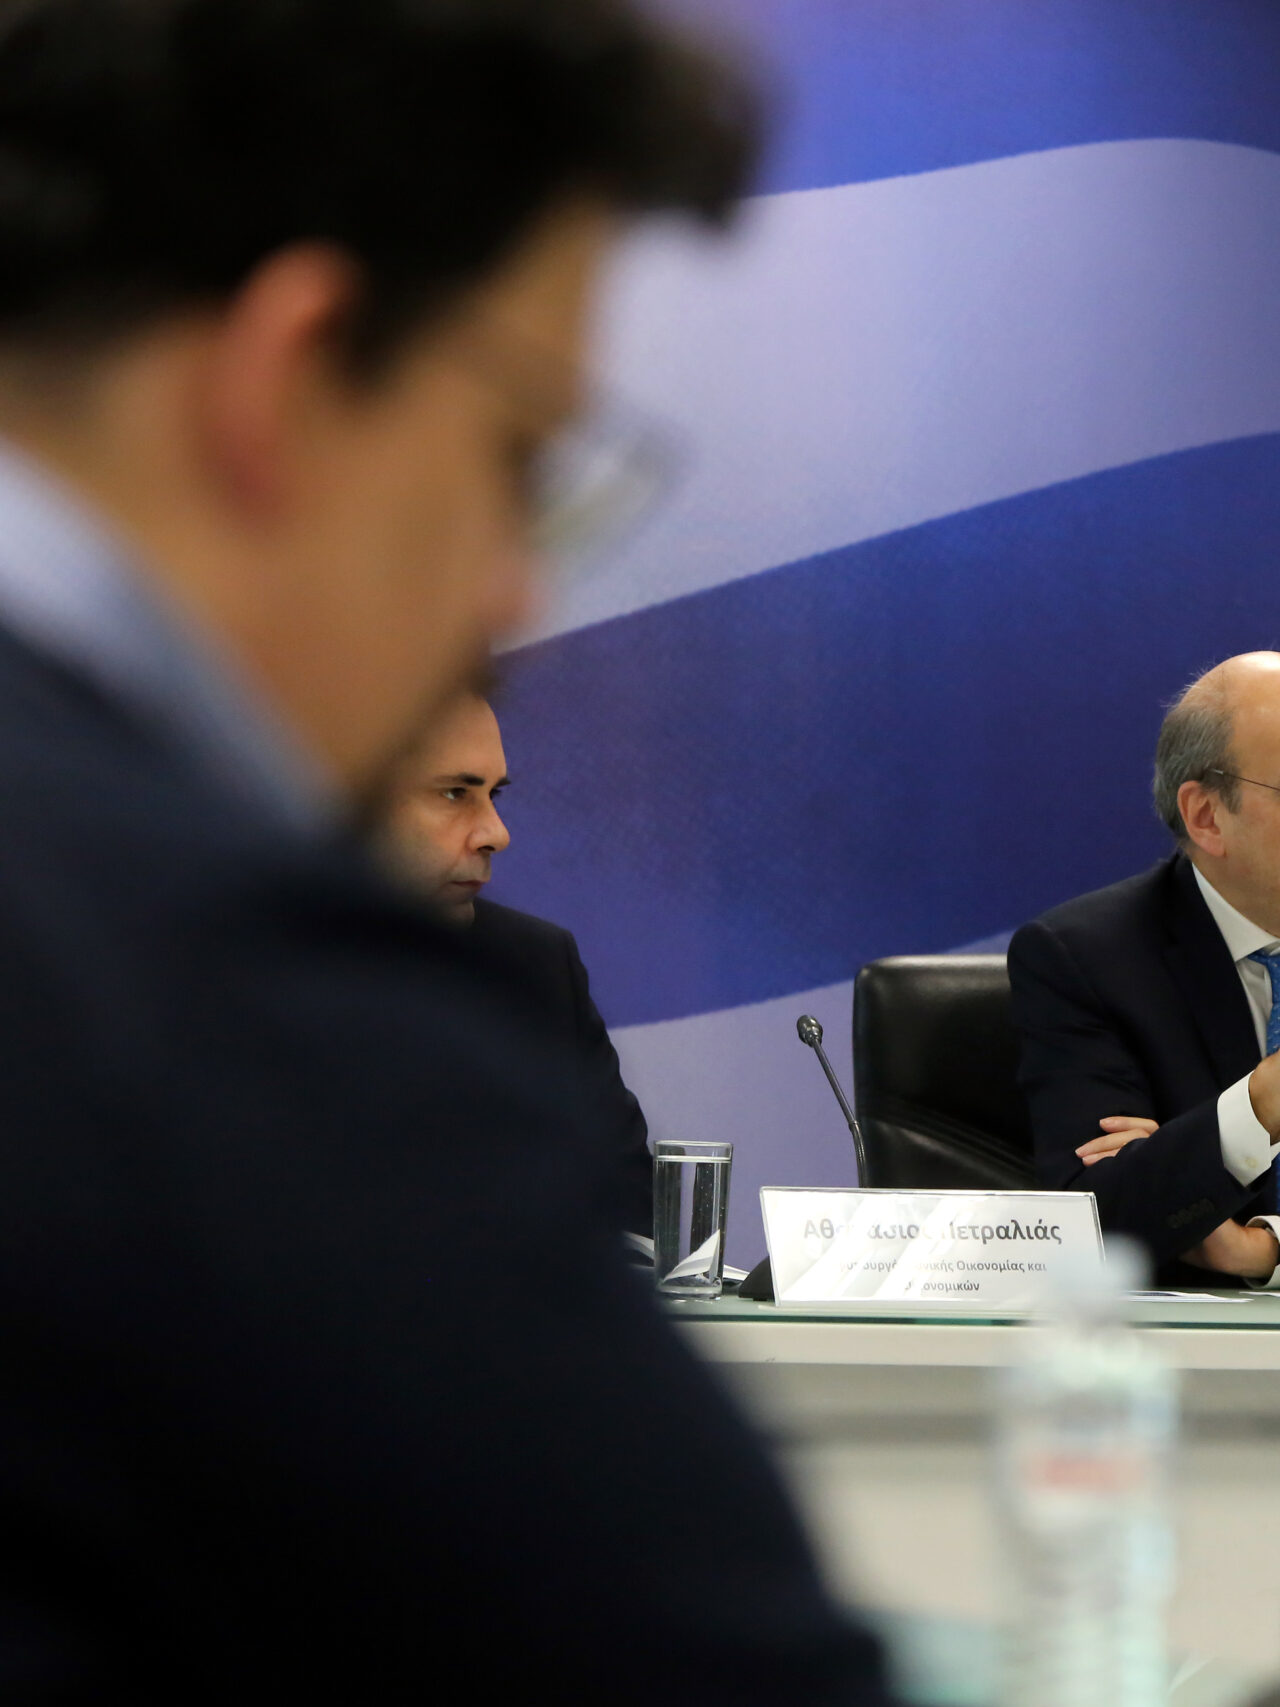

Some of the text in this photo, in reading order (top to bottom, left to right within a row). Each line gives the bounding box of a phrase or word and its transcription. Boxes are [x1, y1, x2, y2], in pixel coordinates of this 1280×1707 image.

[956, 1260, 1025, 1273] Οικονομίας
[1027, 1263, 1047, 1272] και
[903, 1279, 981, 1293] ονομικών
